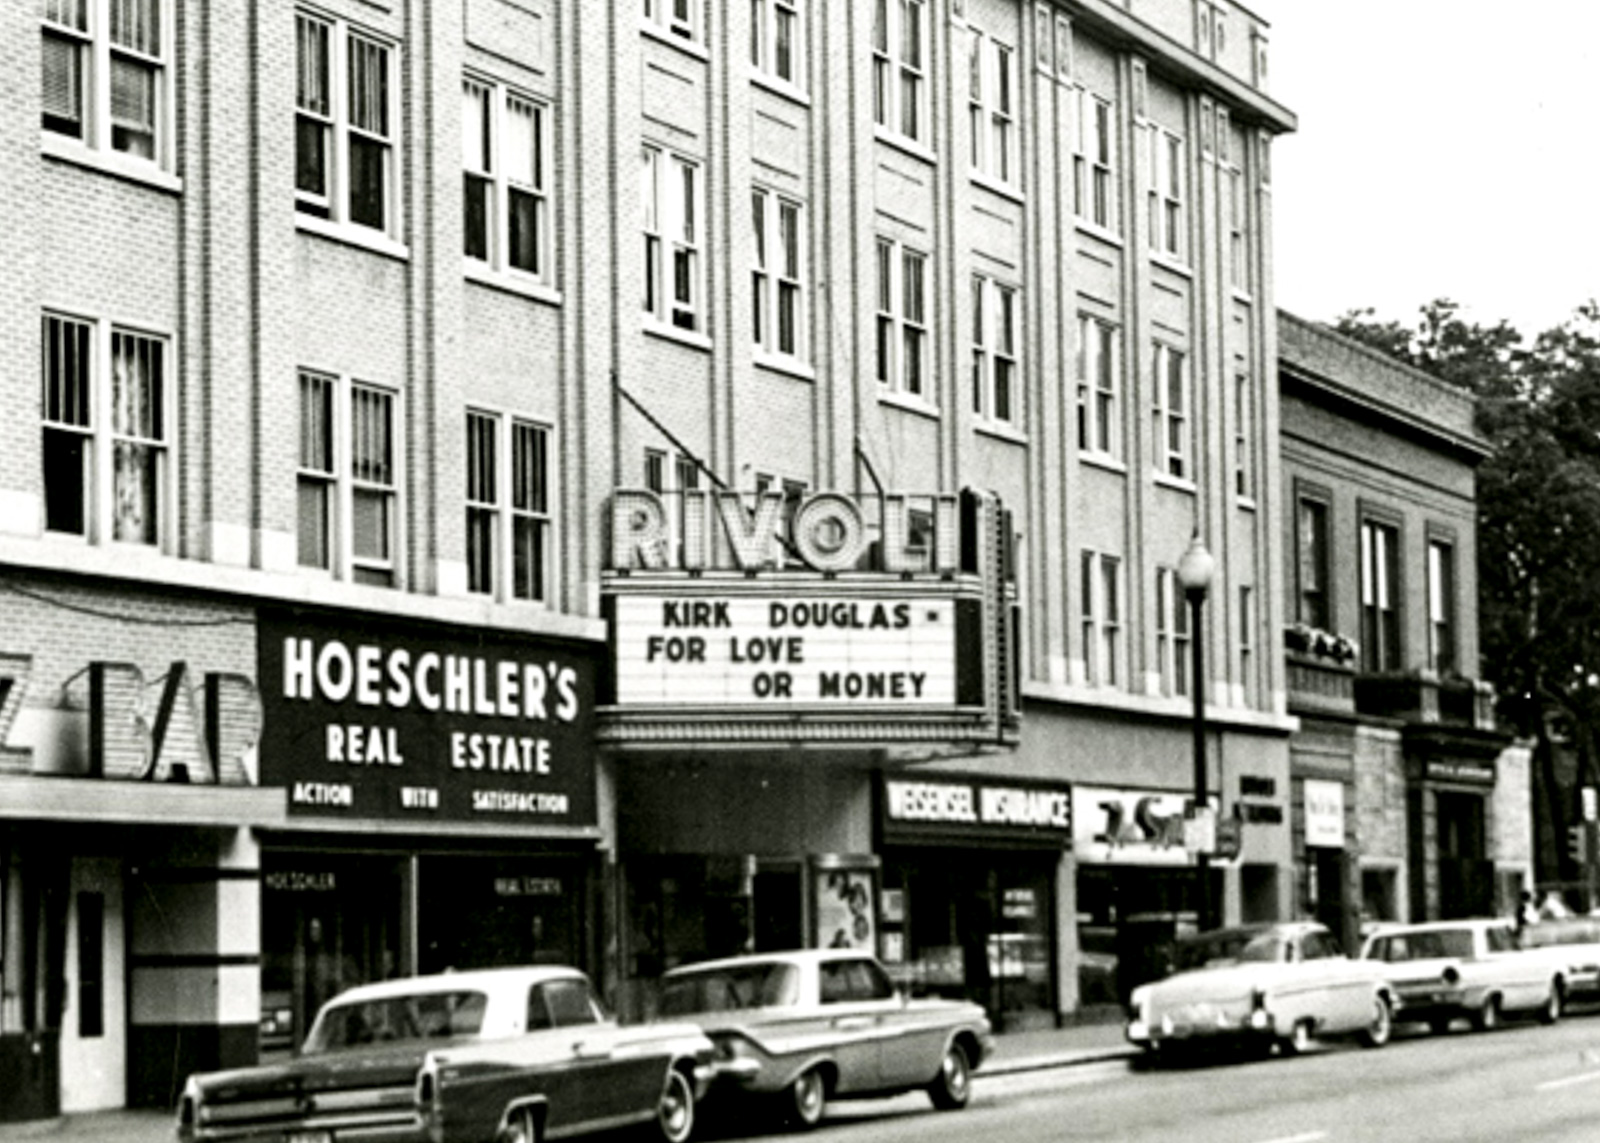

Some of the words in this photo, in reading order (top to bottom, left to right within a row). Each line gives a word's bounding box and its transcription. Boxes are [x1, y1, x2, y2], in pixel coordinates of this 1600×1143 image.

[612, 489, 958, 572] RIVOLI
[662, 601, 732, 628] KIRK
[769, 602, 911, 629] DOUGLAS
[646, 636, 706, 663] FOR
[730, 636, 804, 663] LOVE
[283, 637, 578, 722] HOESCHLER'S
[751, 671, 793, 699] OR
[818, 671, 927, 699] MONEY
[89, 660, 265, 786] BAR
[326, 723, 403, 766] REAL
[450, 732, 552, 774] ESTATE
[293, 782, 353, 806] ACTION
[401, 786, 438, 808] WITH
[472, 789, 568, 814] SATISFACTION
[980, 787, 1070, 828] INSURANCE
